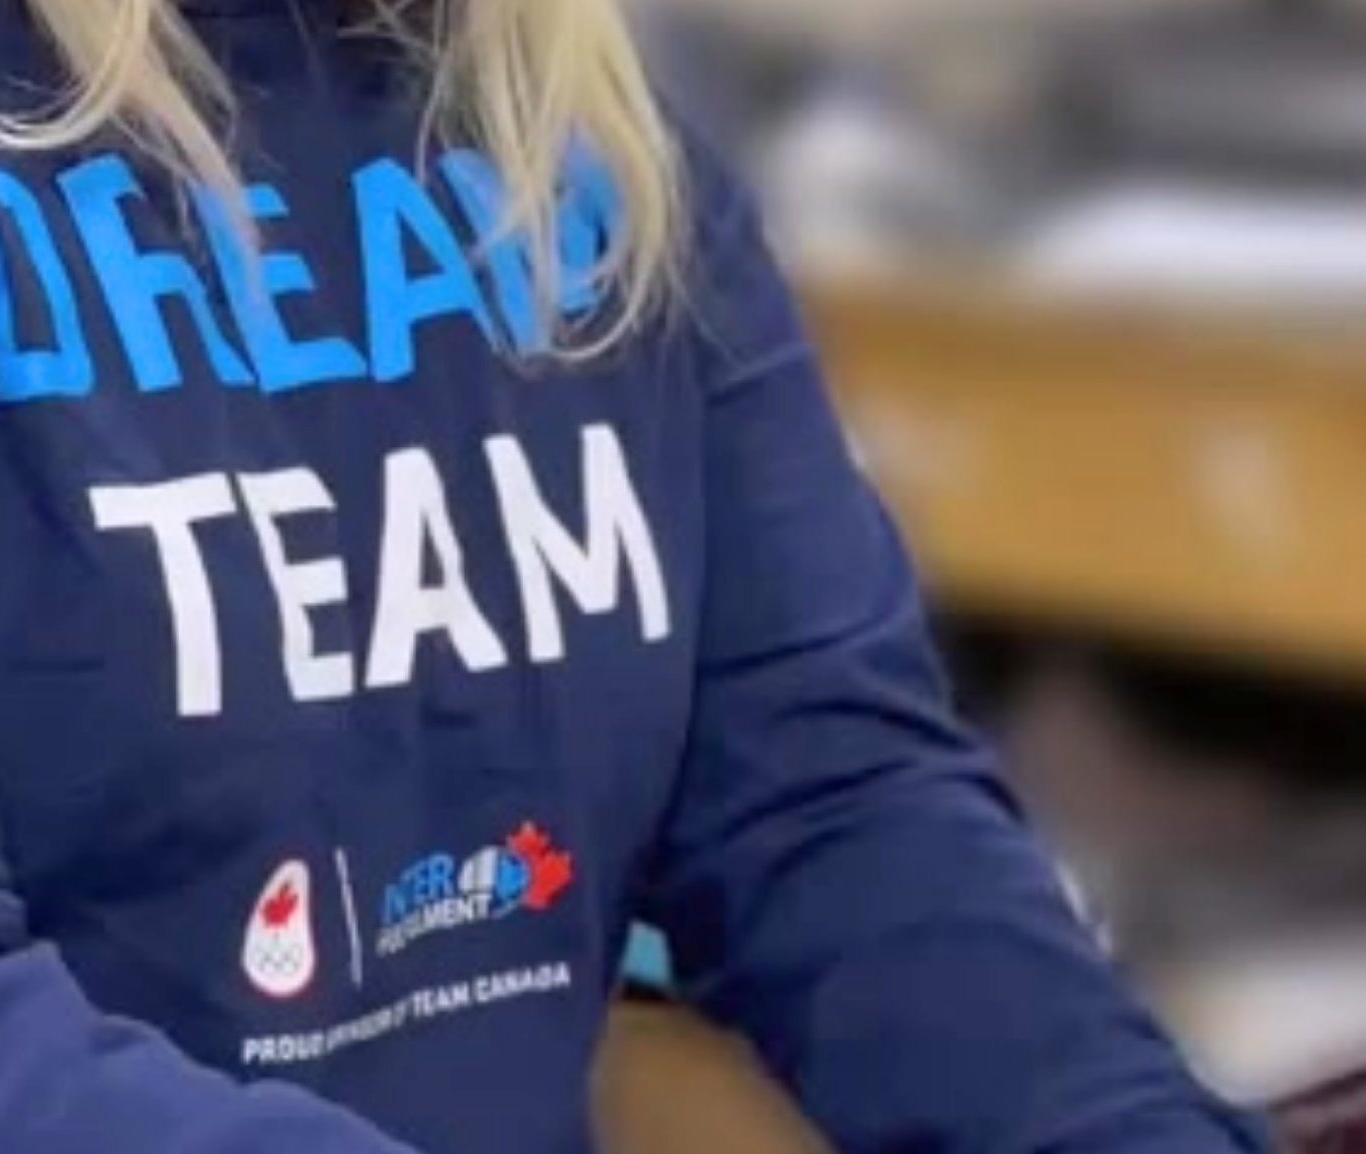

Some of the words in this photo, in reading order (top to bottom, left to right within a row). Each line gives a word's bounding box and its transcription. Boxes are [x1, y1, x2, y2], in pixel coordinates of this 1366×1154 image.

[88, 422, 669, 717] TEAM
[242, 1034, 325, 1065] PROUD
[412, 981, 470, 1018] TEAM
[473, 961, 571, 1003] CANADA
